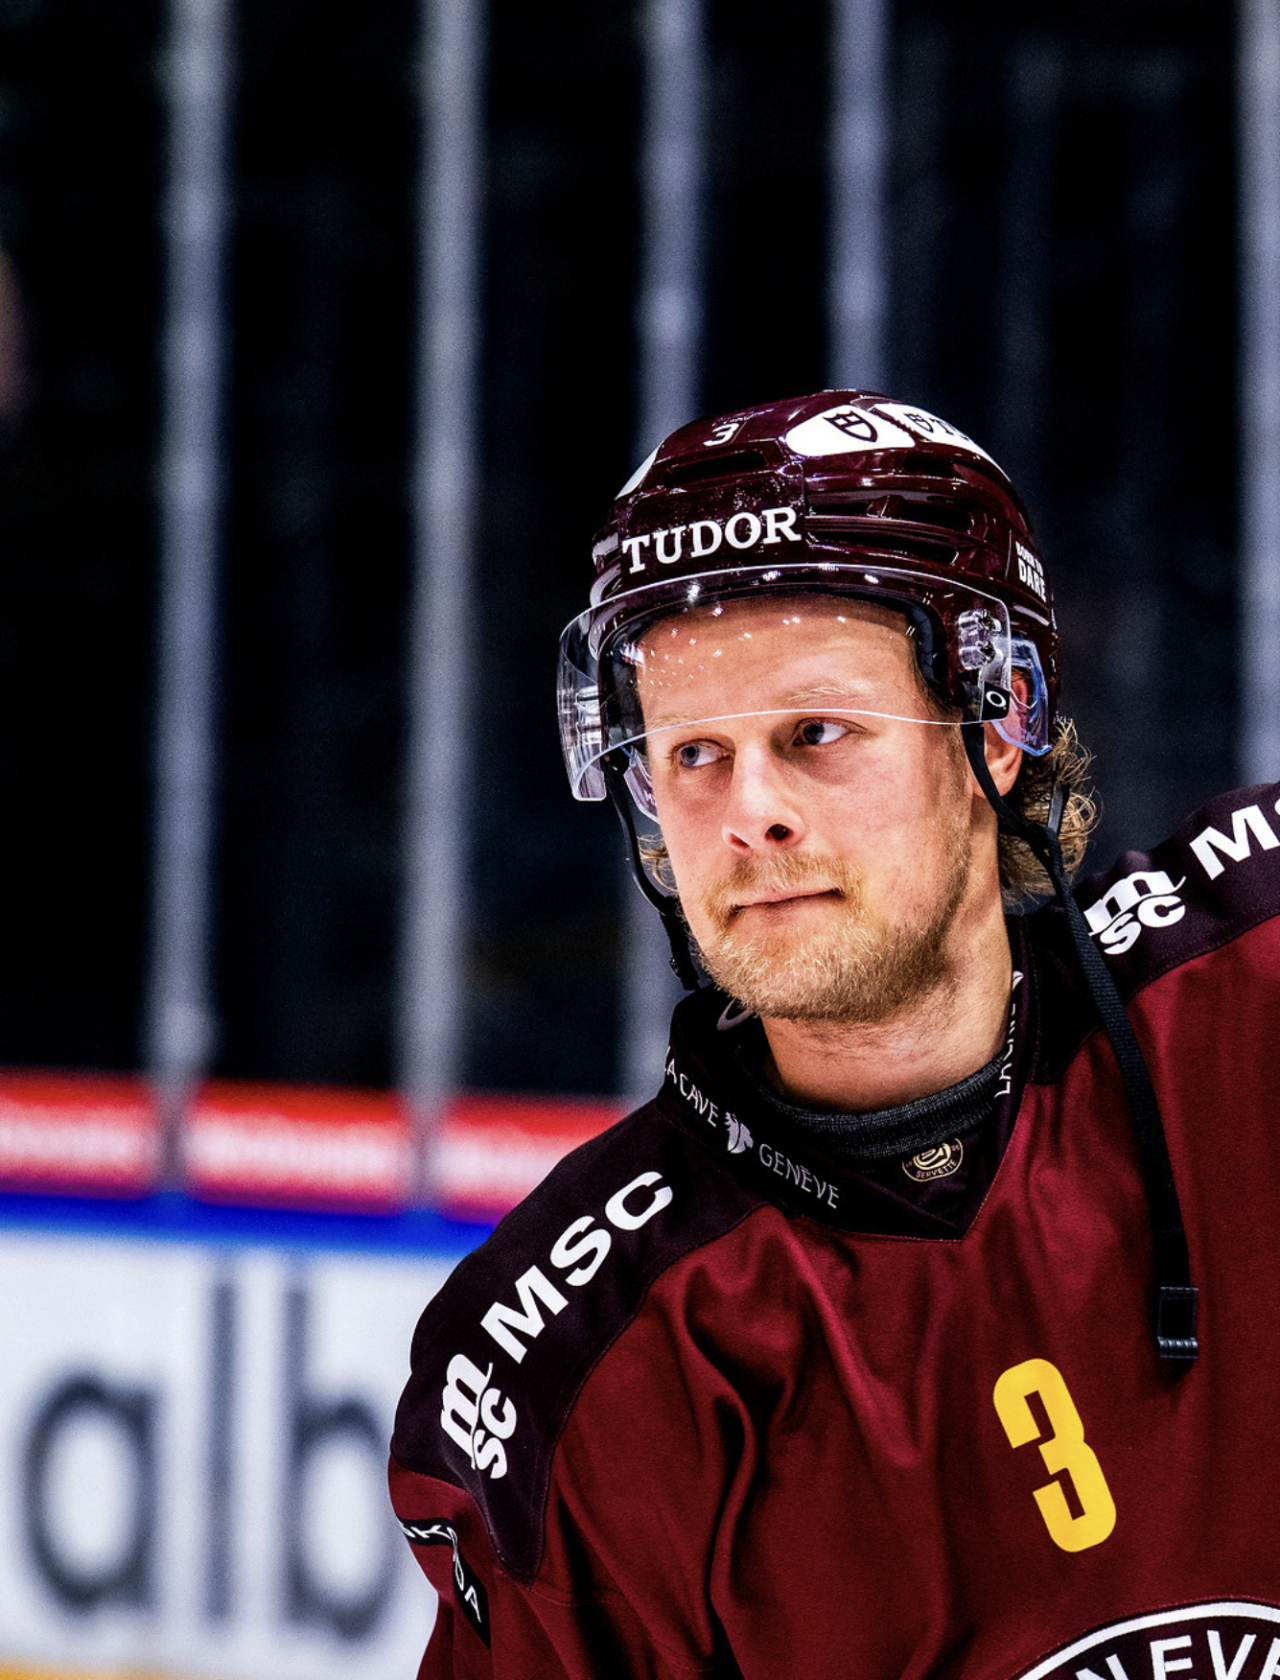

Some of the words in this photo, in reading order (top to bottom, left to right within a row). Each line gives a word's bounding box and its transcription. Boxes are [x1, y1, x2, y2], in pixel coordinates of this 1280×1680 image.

[703, 421, 740, 447] 3
[622, 506, 802, 574] TUDOR
[1017, 556, 1047, 604] DARE
[678, 1072, 720, 1128] CAVE
[916, 1159, 957, 1178] SERVETTE
[480, 1170, 674, 1364] MSC
[993, 1358, 1117, 1553] 3
